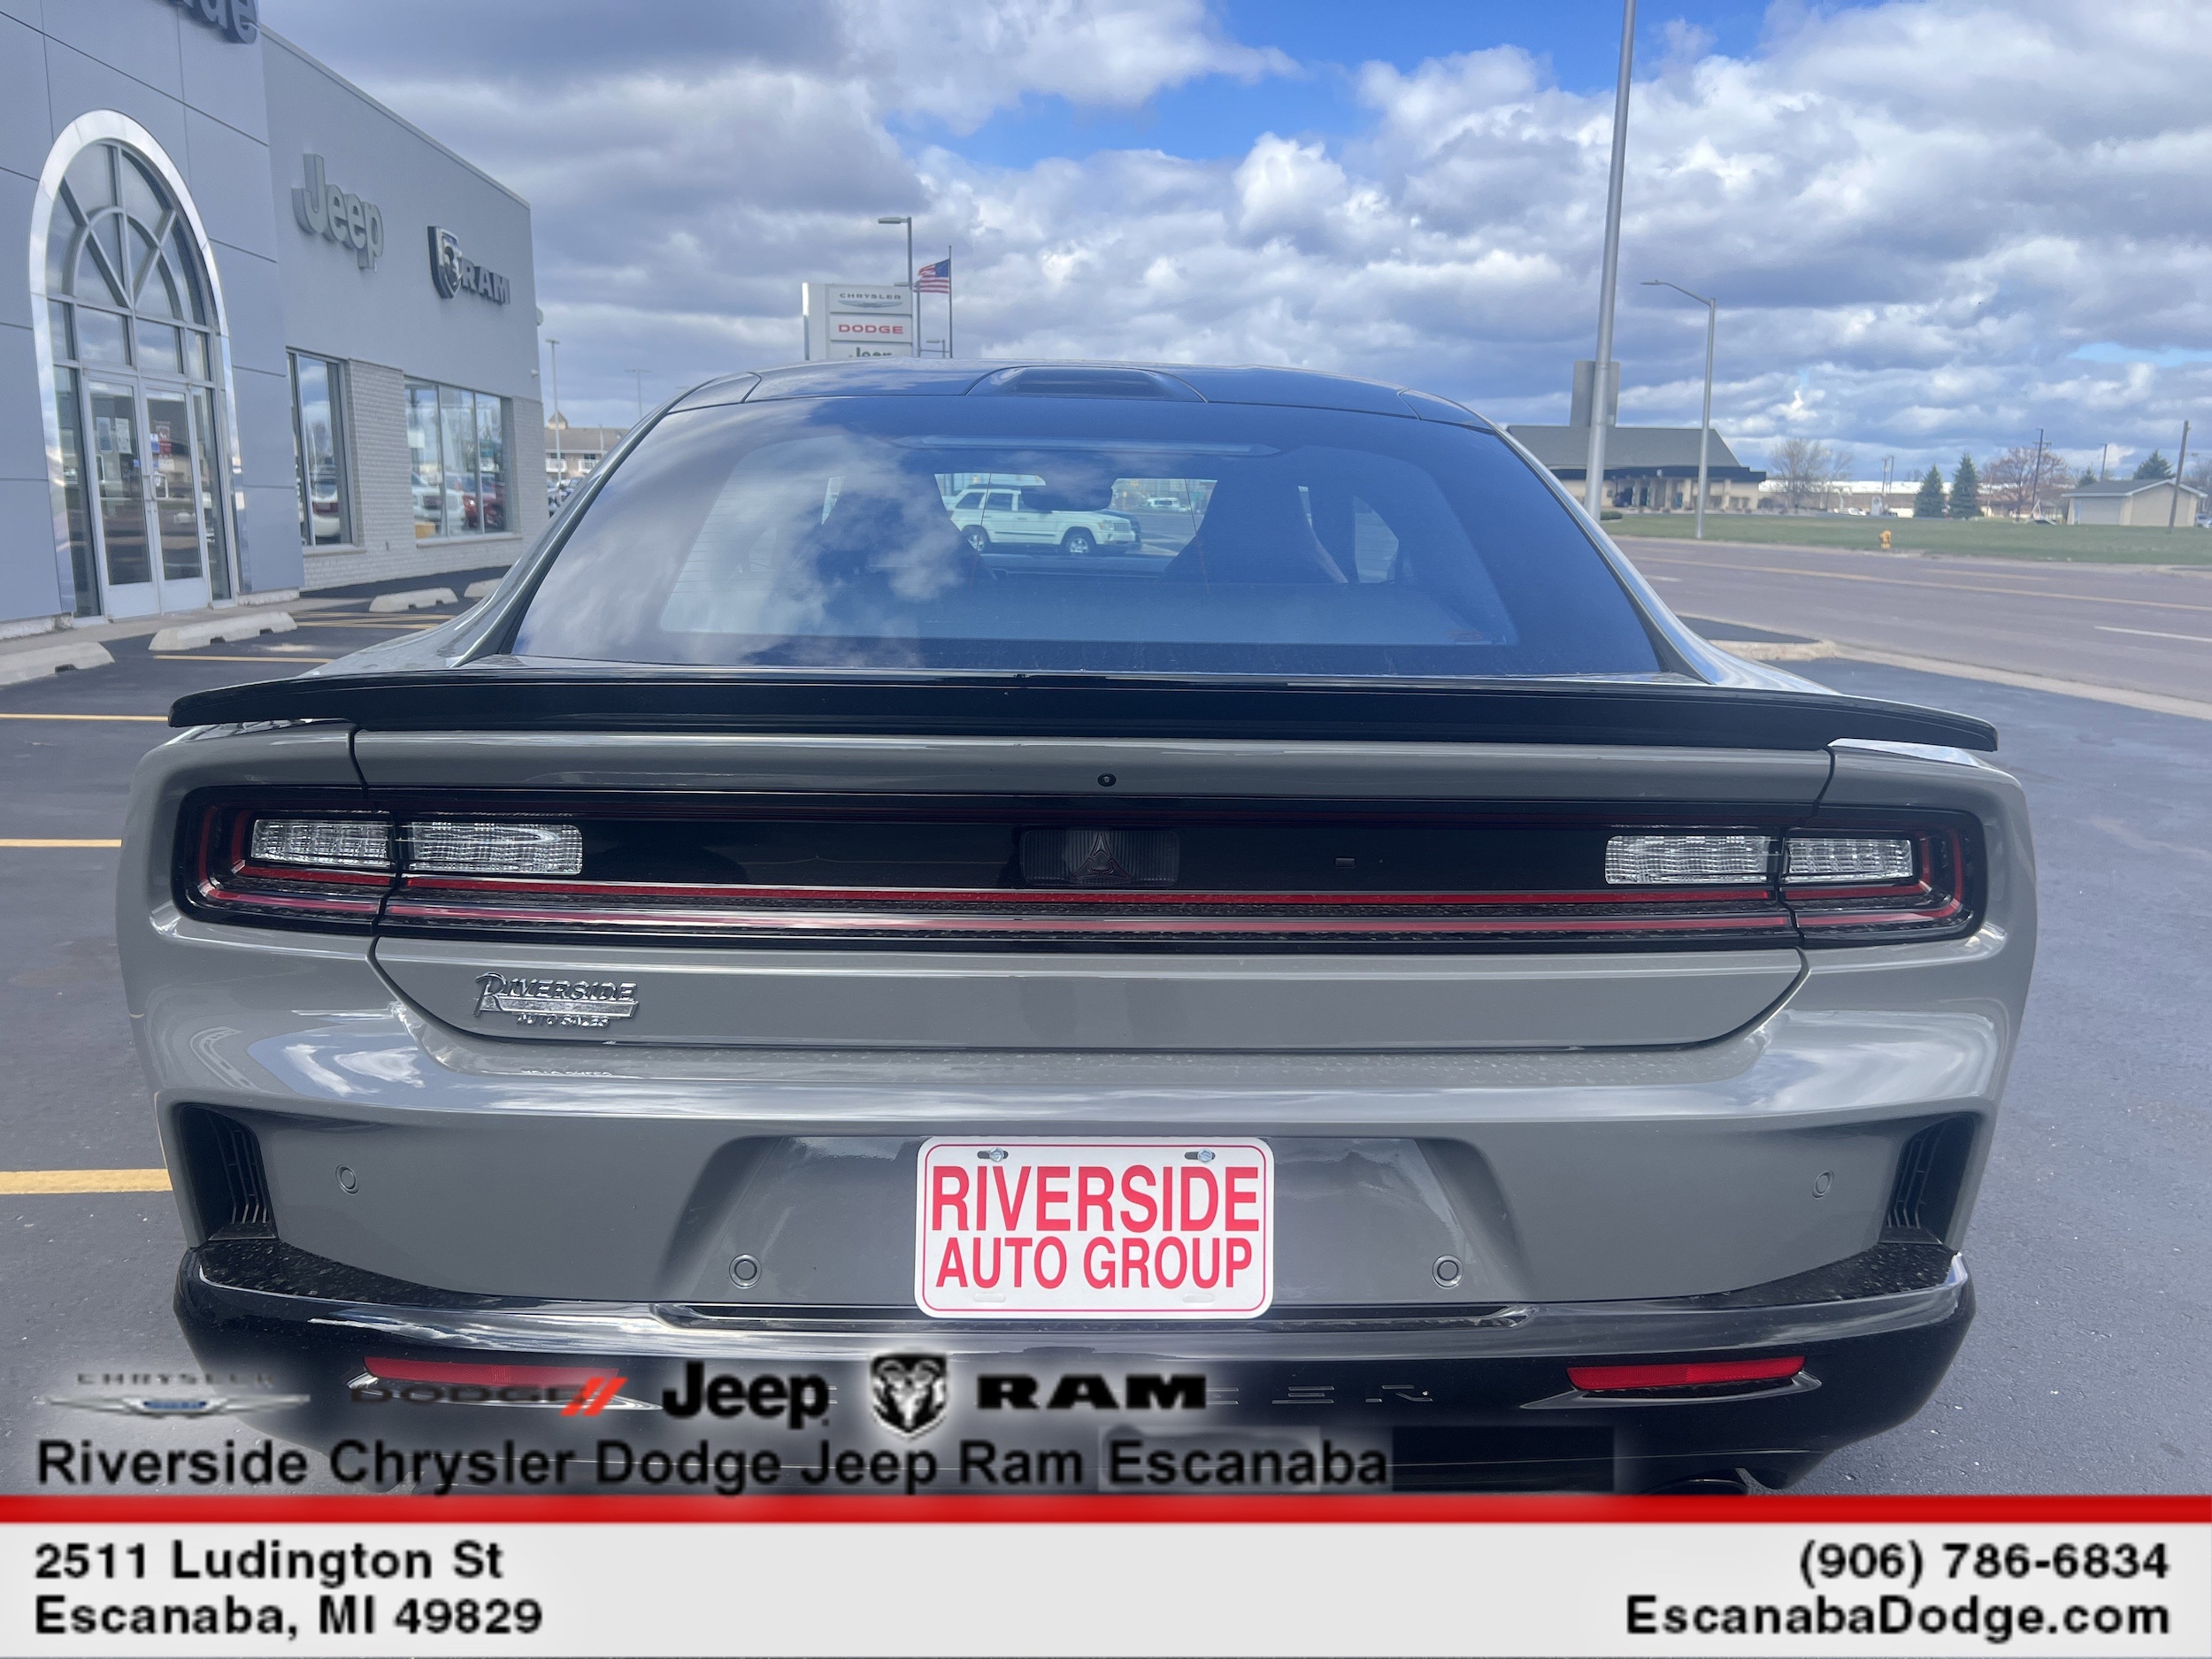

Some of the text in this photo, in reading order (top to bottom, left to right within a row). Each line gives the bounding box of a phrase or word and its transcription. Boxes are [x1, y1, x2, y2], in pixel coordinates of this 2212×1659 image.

[291, 153, 383, 269] Jeep
[460, 257, 511, 303] RAM
[838, 324, 903, 334] DODGE
[472, 972, 638, 1017] RIVERSIDE
[932, 1165, 1260, 1233] RIVERSIDE
[935, 1236, 1252, 1289] AUTO GROUP
